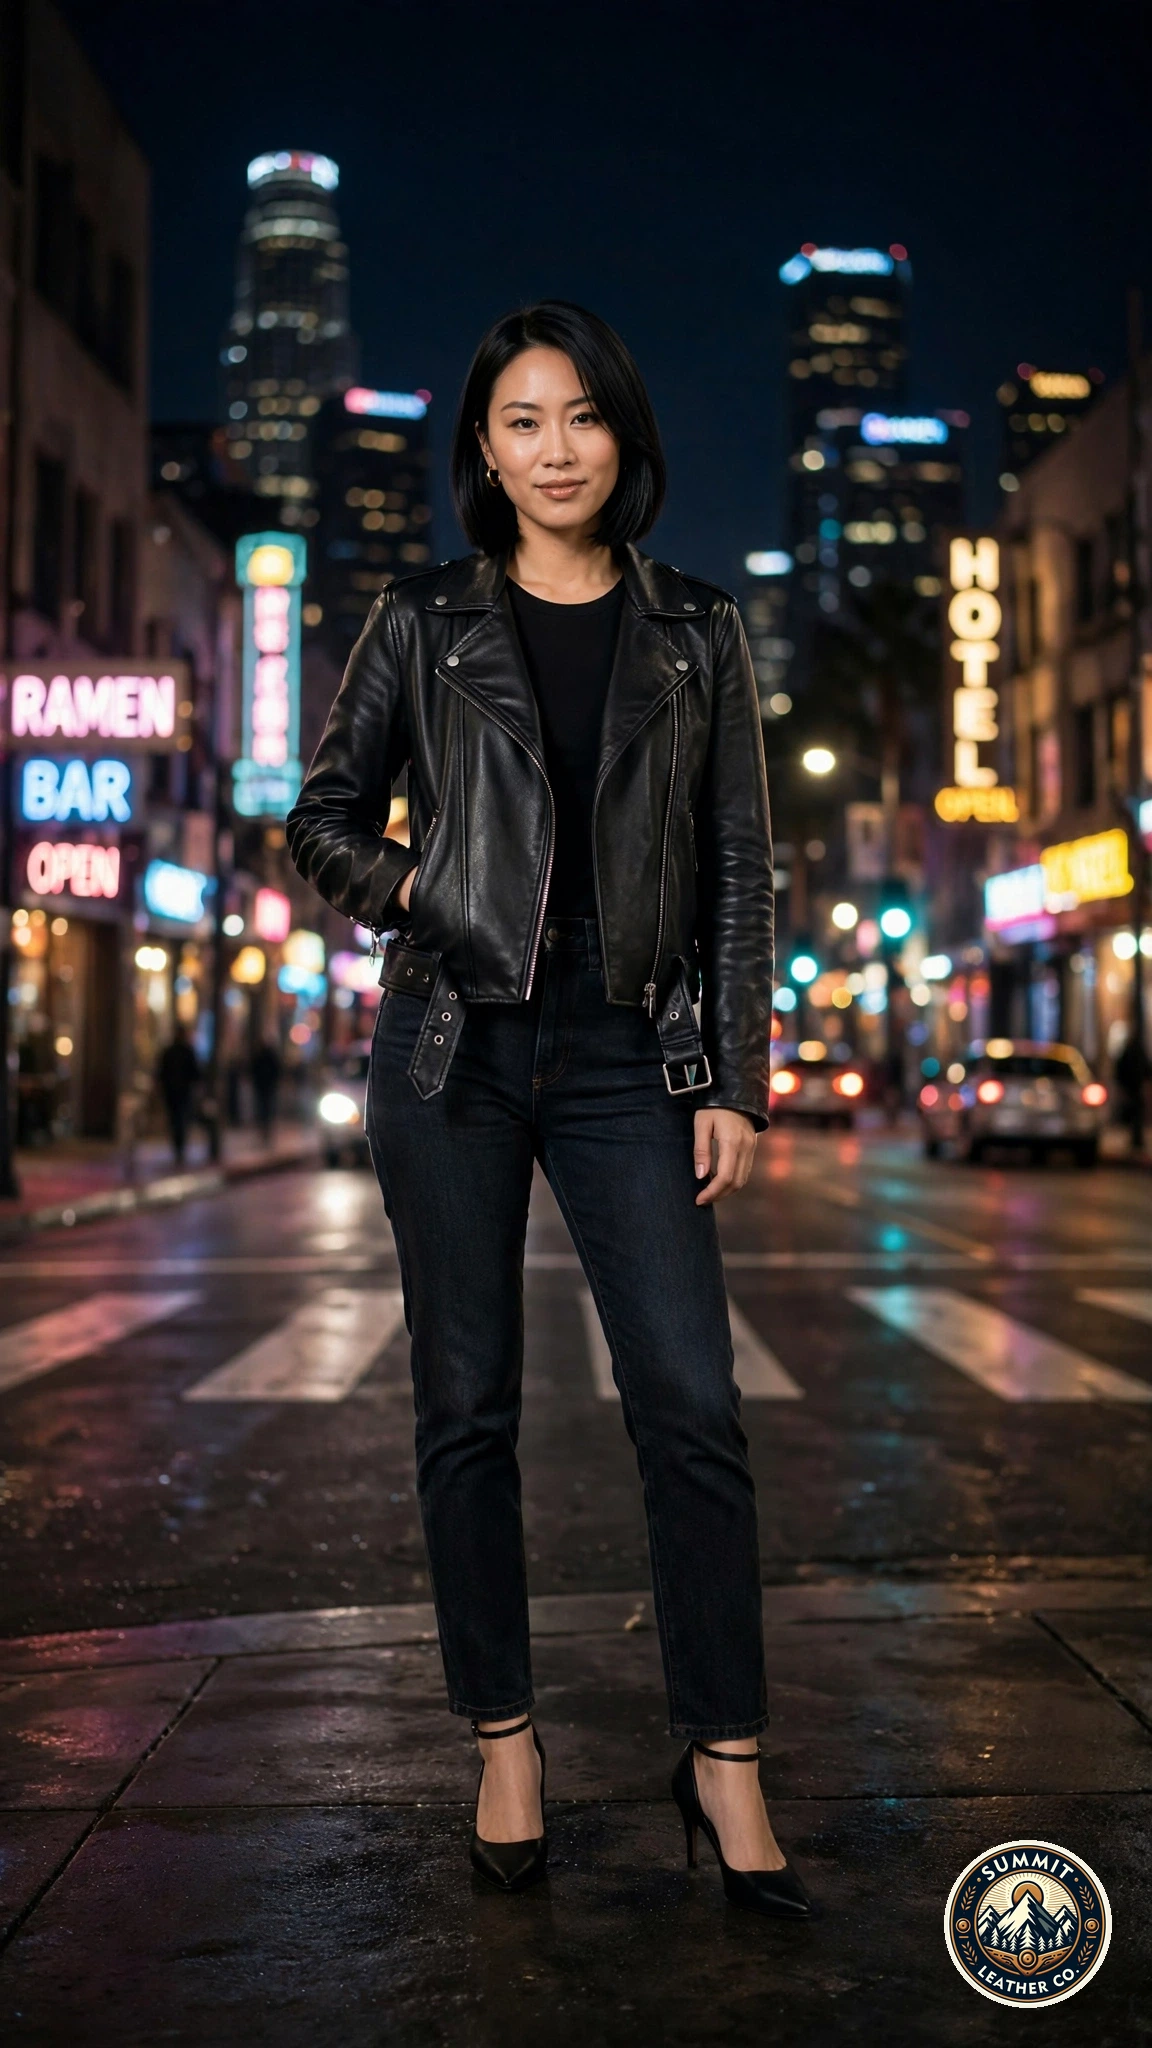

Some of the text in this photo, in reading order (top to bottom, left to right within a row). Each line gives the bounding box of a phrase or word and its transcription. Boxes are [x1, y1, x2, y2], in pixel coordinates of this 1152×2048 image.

[949, 537, 1001, 787] HOTEL
[12, 675, 175, 738] RAMEN
[23, 759, 132, 822] BAR
[27, 841, 120, 898] OPEN
